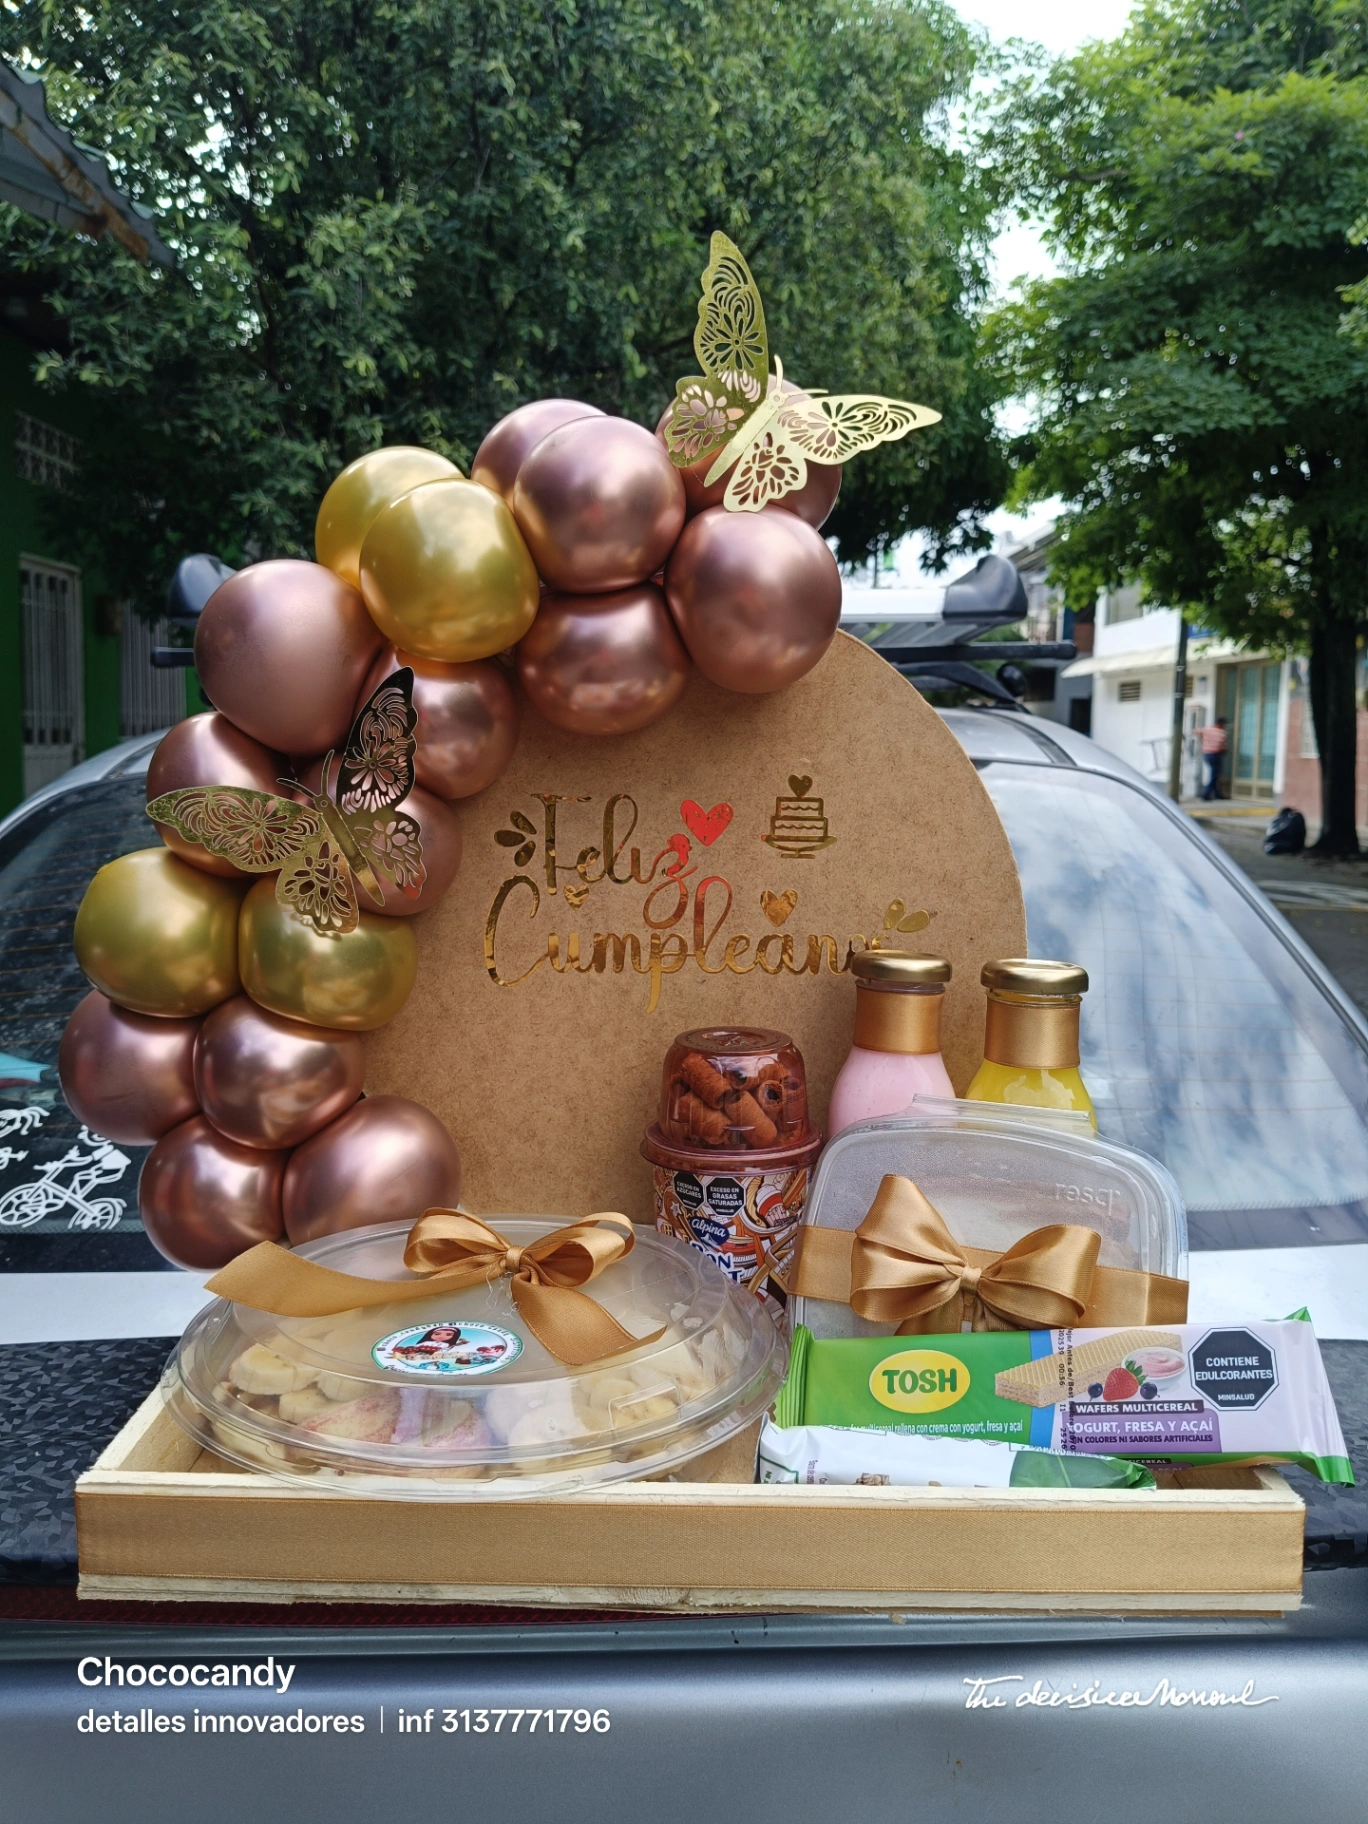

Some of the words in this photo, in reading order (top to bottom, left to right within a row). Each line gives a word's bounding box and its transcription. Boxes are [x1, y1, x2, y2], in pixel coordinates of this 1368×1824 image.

[530, 793, 698, 930] Feliz
[712, 1192, 738, 1200] GRASAS
[1205, 1356, 1260, 1367] CONTIENE
[1195, 1369, 1273, 1380] EDULCORANTES
[881, 1367, 958, 1395] TOSH
[1217, 1393, 1255, 1401] MINSALUD
[1075, 1404, 1119, 1413] WAFERS
[1122, 1402, 1198, 1412] MULTICEREAL
[916, 1425, 928, 1433] con
[928, 1424, 948, 1433] crema
[949, 1424, 961, 1433] con
[962, 1422, 986, 1435] yogurt,
[986, 1420, 1003, 1432] fresa
[1003, 1422, 1009, 1433] y
[1009, 1418, 1023, 1433] açaí
[1125, 1421, 1165, 1432] FRESA
[1168, 1421, 1177, 1431] Y
[1180, 1417, 1213, 1434] AÇAÍ
[1085, 1435, 1118, 1443] COLORES
[1129, 1435, 1162, 1443] SABORES
[1164, 1434, 1213, 1442] ARTIFICIALES
